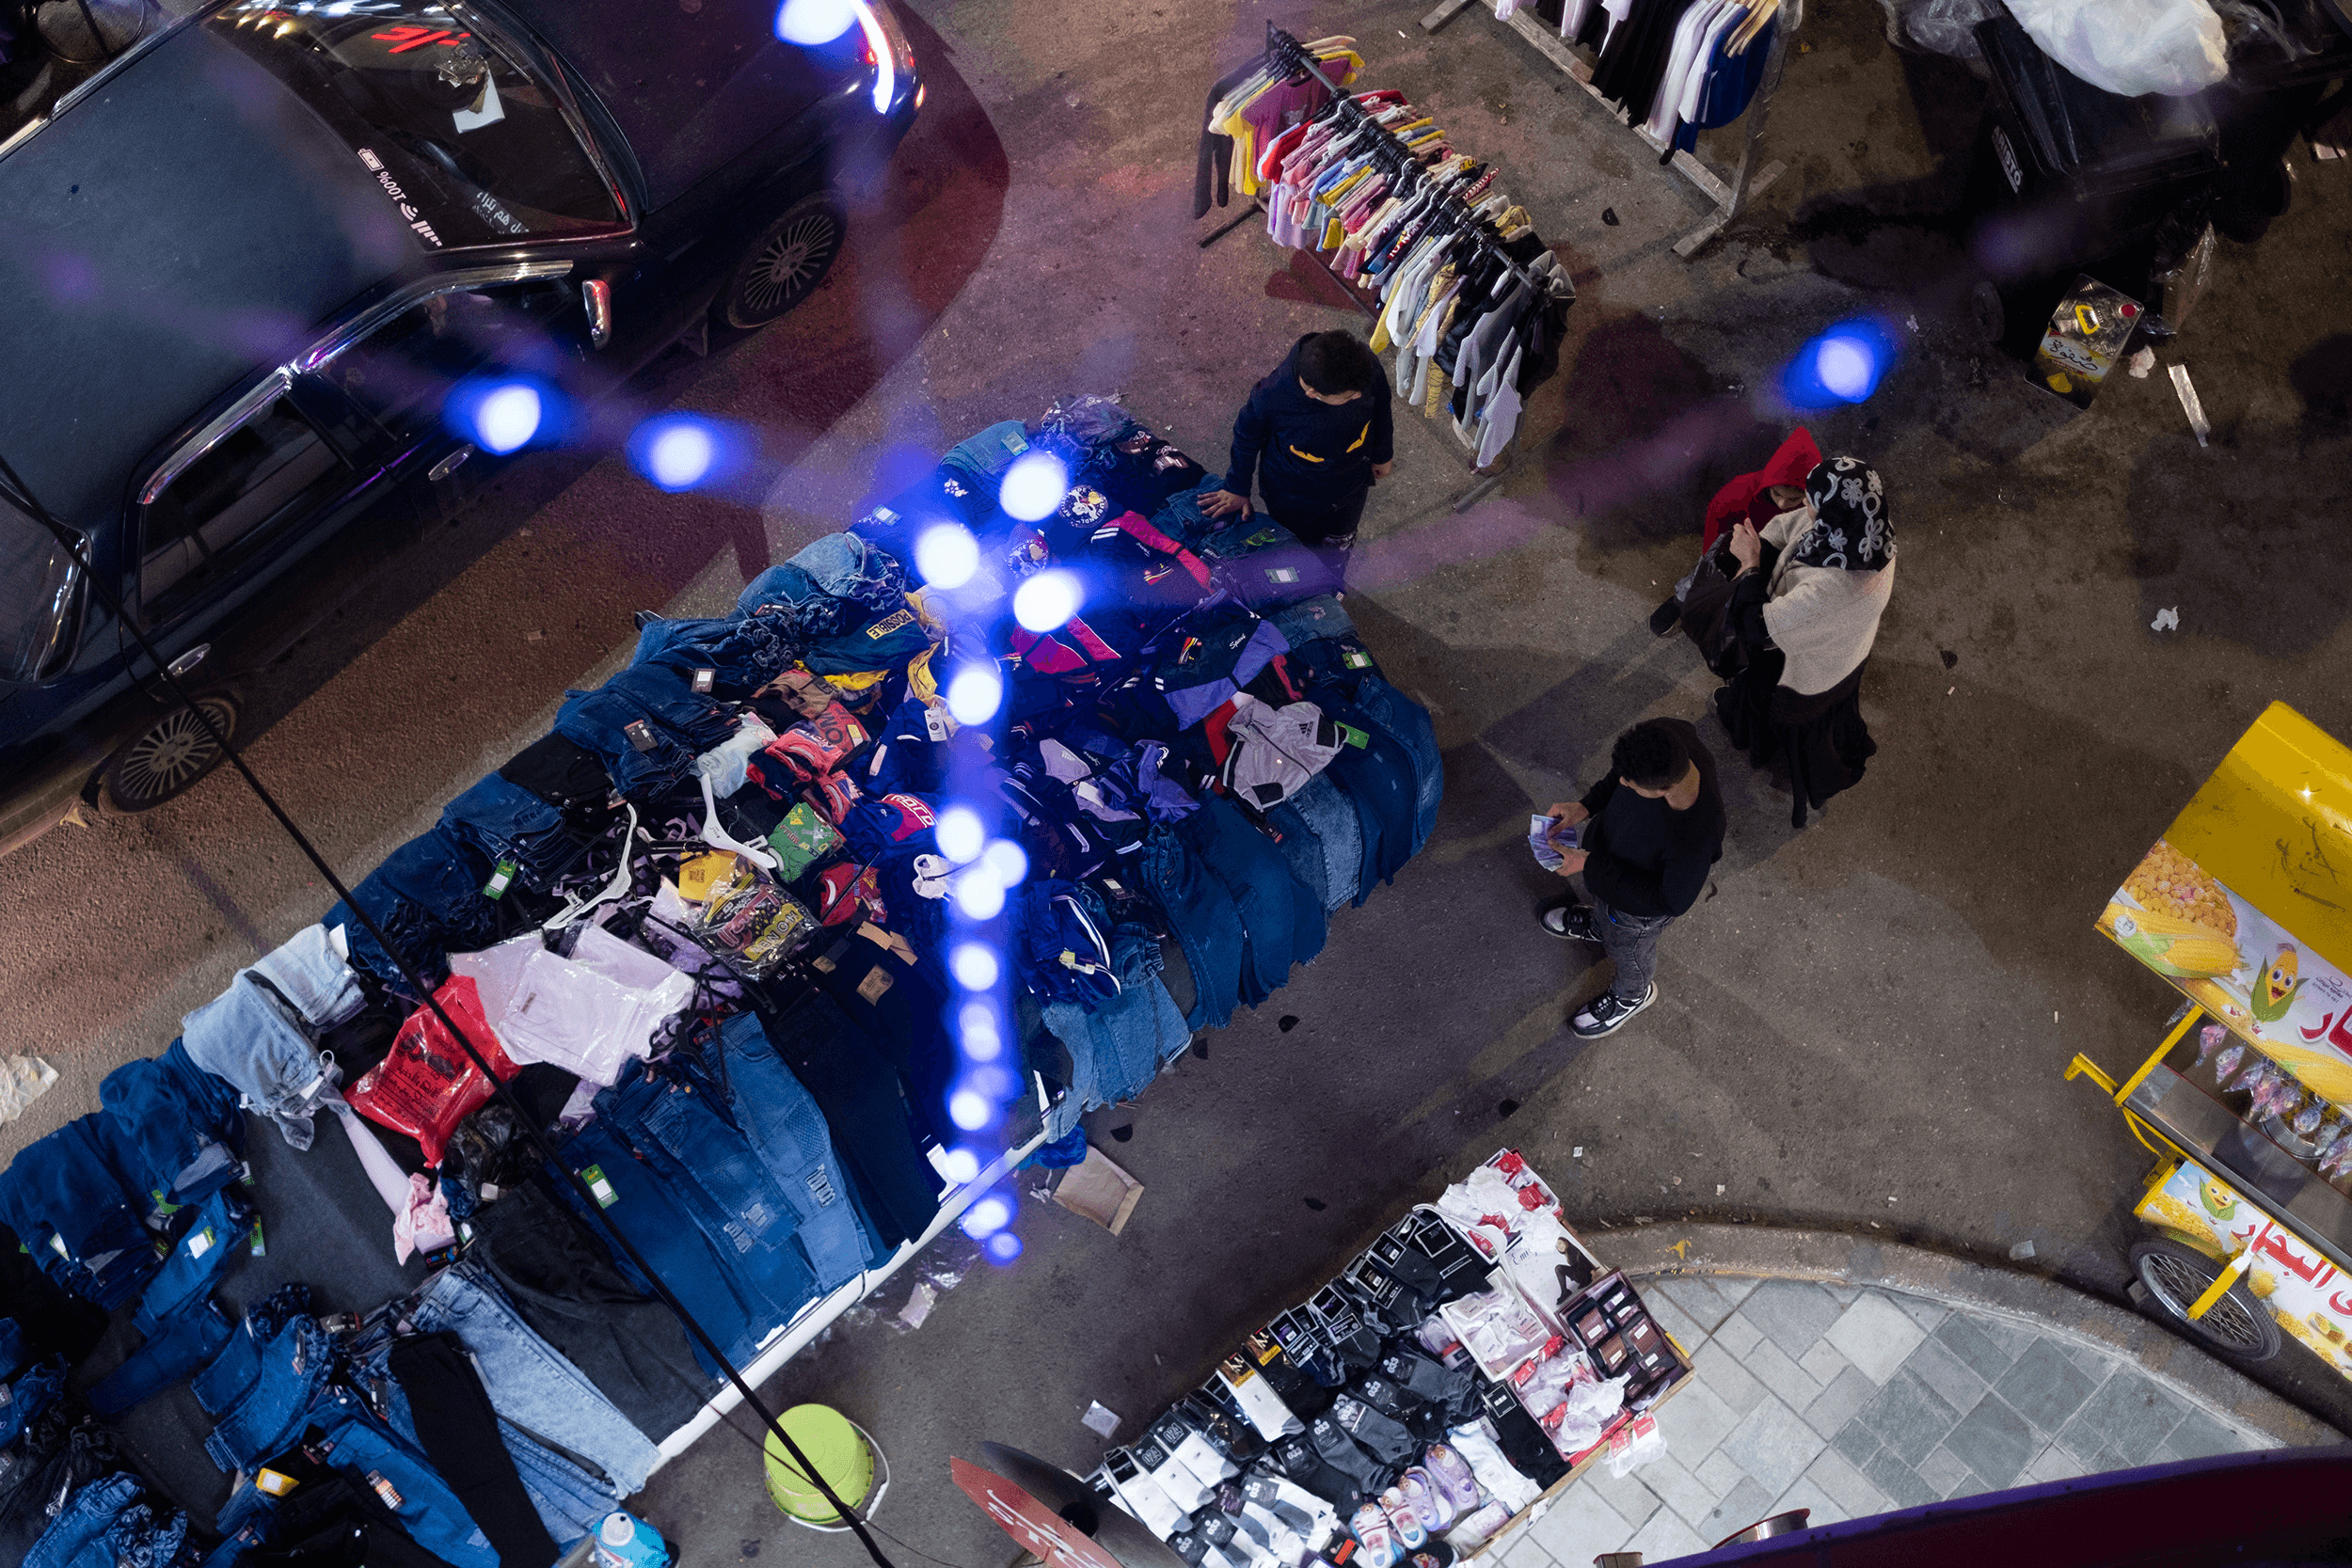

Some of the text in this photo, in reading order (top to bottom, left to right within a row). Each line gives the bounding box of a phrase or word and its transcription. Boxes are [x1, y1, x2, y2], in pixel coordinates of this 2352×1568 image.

[1992, 124, 2022, 186] ARISTO
[377, 170, 406, 201] 100%
[867, 610, 910, 638] POSSIBLE
[1305, 720, 1313, 737] adidas
[749, 910, 799, 956] HONEY
[1387, 1356, 1399, 1373] 033
[1367, 1381, 1381, 1397] 033
[1163, 1422, 1184, 1444] 024
[1313, 1421, 1330, 1435] 033
[1141, 1445, 1162, 1467] 024
[1286, 1446, 1303, 1460] 033
